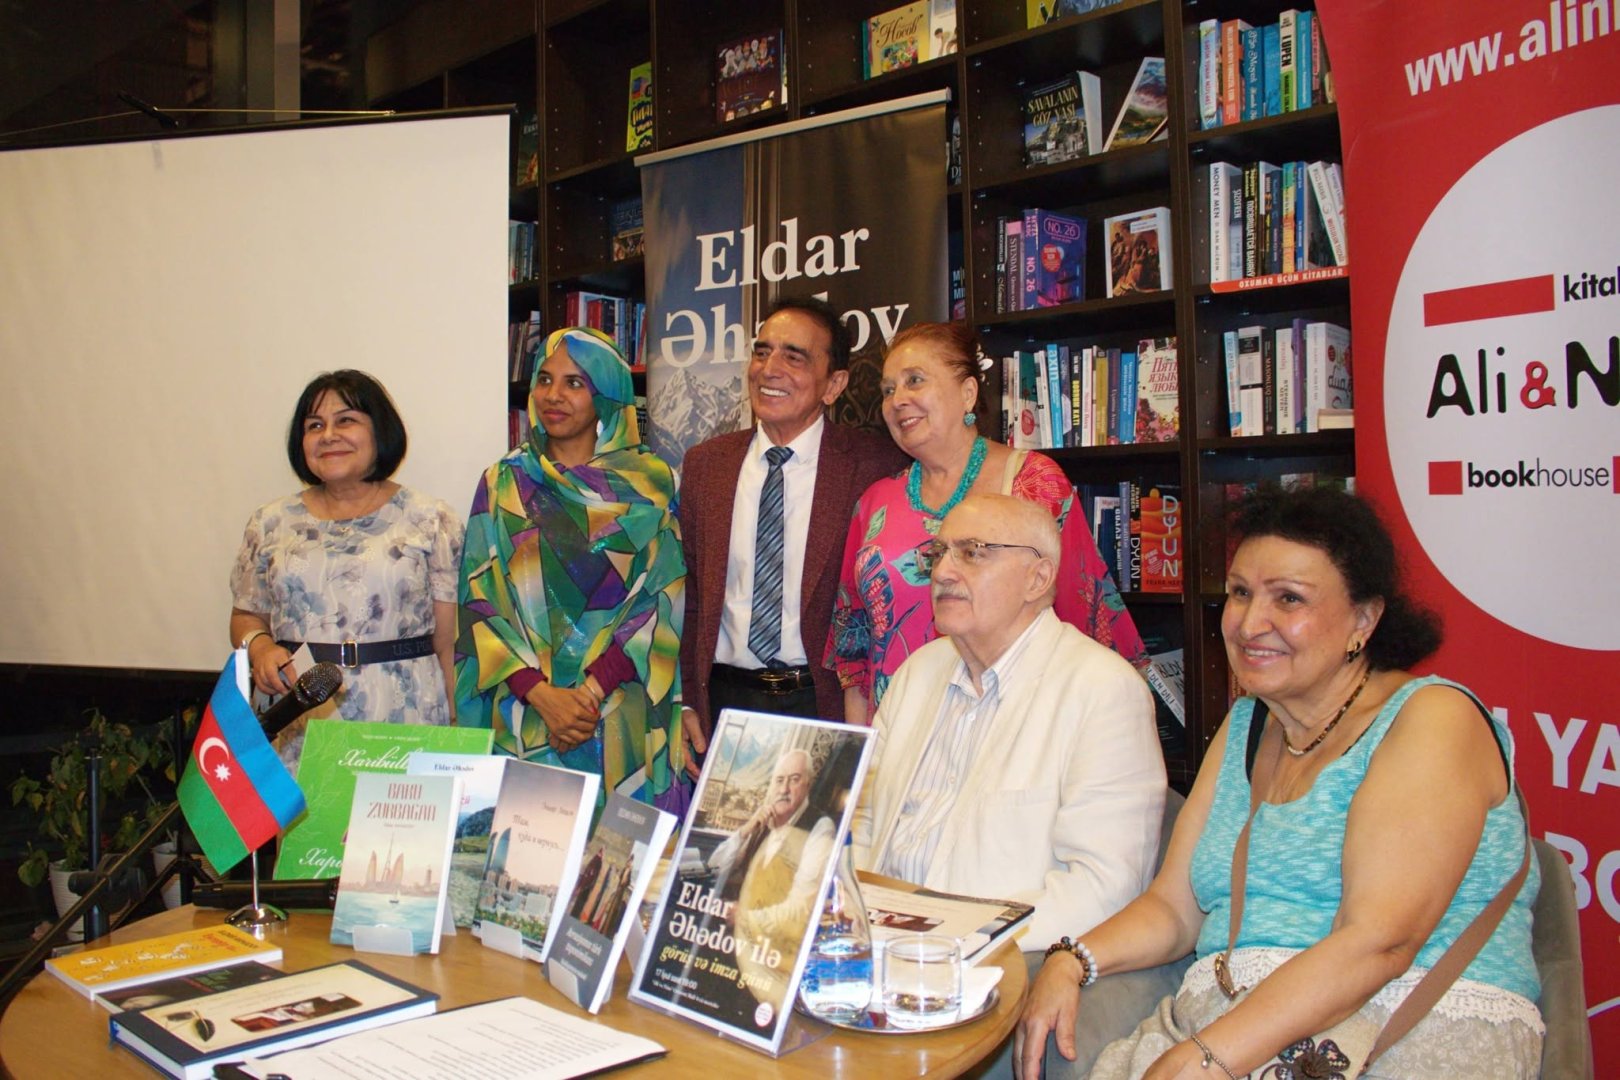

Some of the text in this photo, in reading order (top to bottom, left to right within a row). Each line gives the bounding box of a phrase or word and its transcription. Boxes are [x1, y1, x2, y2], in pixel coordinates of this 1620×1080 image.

[1404, 0, 1620, 96] www.alin
[1064, 224, 1076, 237] 26
[694, 217, 870, 292] Eldar
[1026, 278, 1035, 293] 26
[1238, 276, 1274, 288] OXUMAQ
[1563, 265, 1620, 302] kita
[660, 293, 910, 368] Əhov
[1467, 457, 1610, 488] bookhouse
[1130, 537, 1141, 579] DYUN
[676, 881, 734, 919] Eldar
[669, 911, 782, 969] Əhədov ilə
[659, 944, 773, 992] görüş və imza günü
